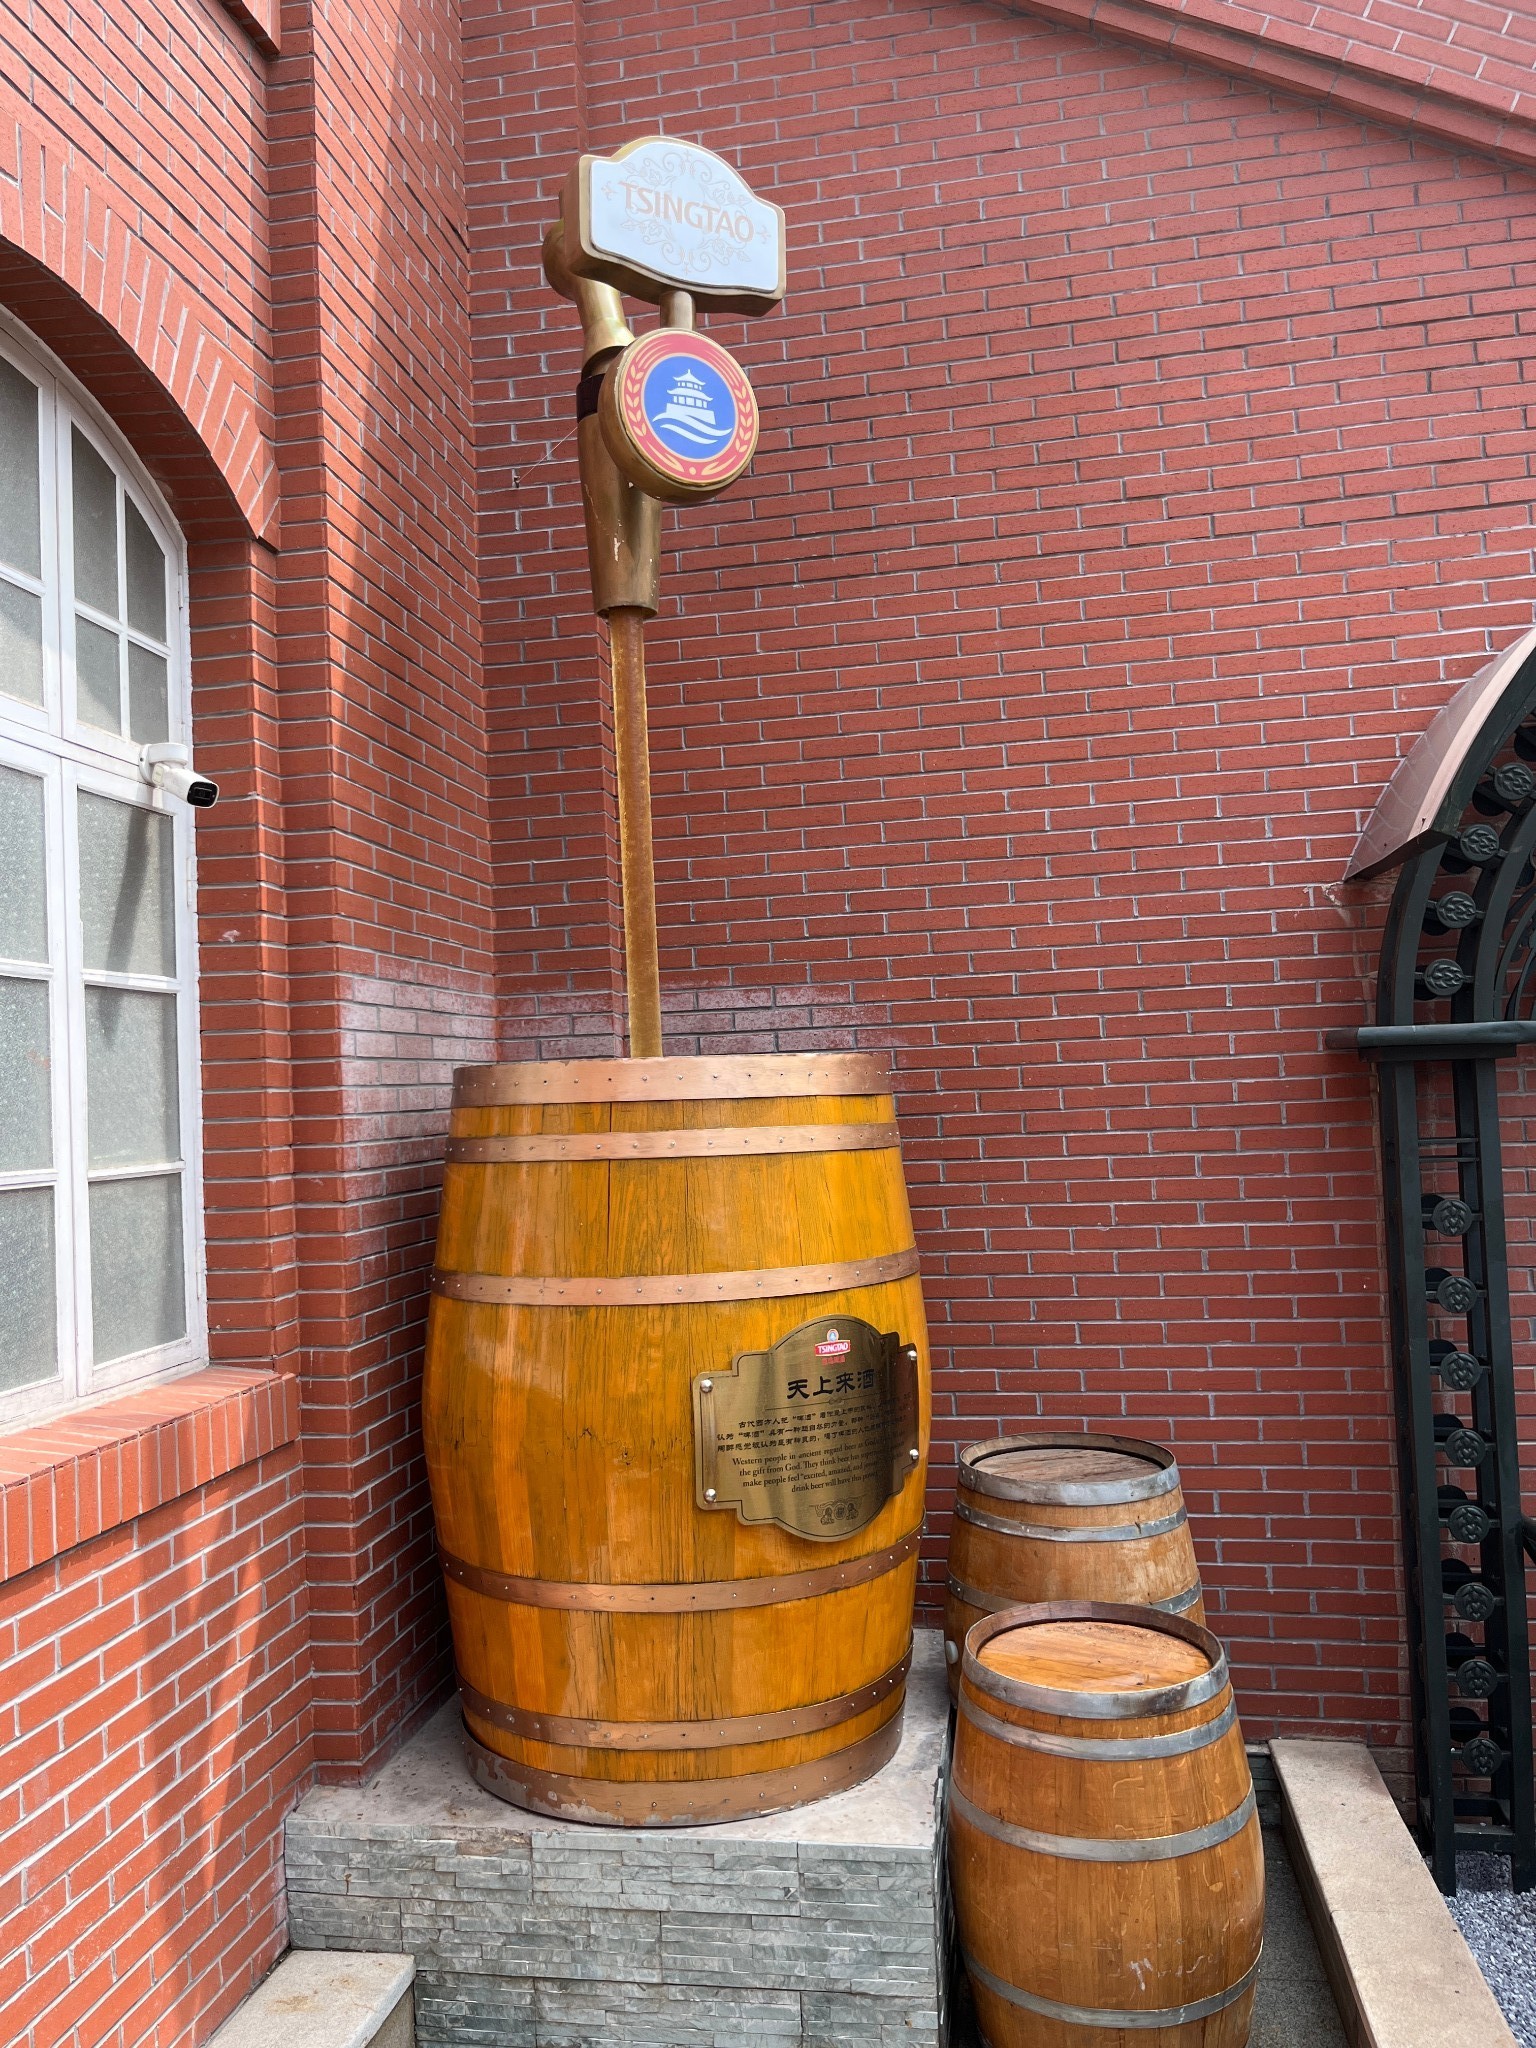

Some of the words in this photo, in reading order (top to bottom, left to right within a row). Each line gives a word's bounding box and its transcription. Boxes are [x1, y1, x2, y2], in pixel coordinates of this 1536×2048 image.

[617, 179, 754, 243] TSINGTAO
[817, 1342, 849, 1354] TSINGTAO
[786, 1368, 875, 1400] 天上来酒
[732, 1457, 762, 1466] Western
[764, 1453, 787, 1466] people
[789, 1452, 796, 1460] in
[798, 1449, 822, 1459] ancient
[823, 1445, 843, 1456] regard
[844, 1443, 857, 1451] beer
[739, 1468, 751, 1477] the
[752, 1467, 765, 1478] gift
[766, 1465, 783, 1474] from
[785, 1463, 803, 1472] God.
[803, 1460, 819, 1470] They
[820, 1458, 836, 1468] think
[742, 1478, 762, 1488] make
[763, 1475, 787, 1488] people
[788, 1473, 800, 1482] feel
[853, 1463, 863, 1471] and
[791, 1482, 810, 1493] drink
[810, 1482, 824, 1490] beer
[824, 1478, 837, 1488] will
[837, 1477, 851, 1485] have
